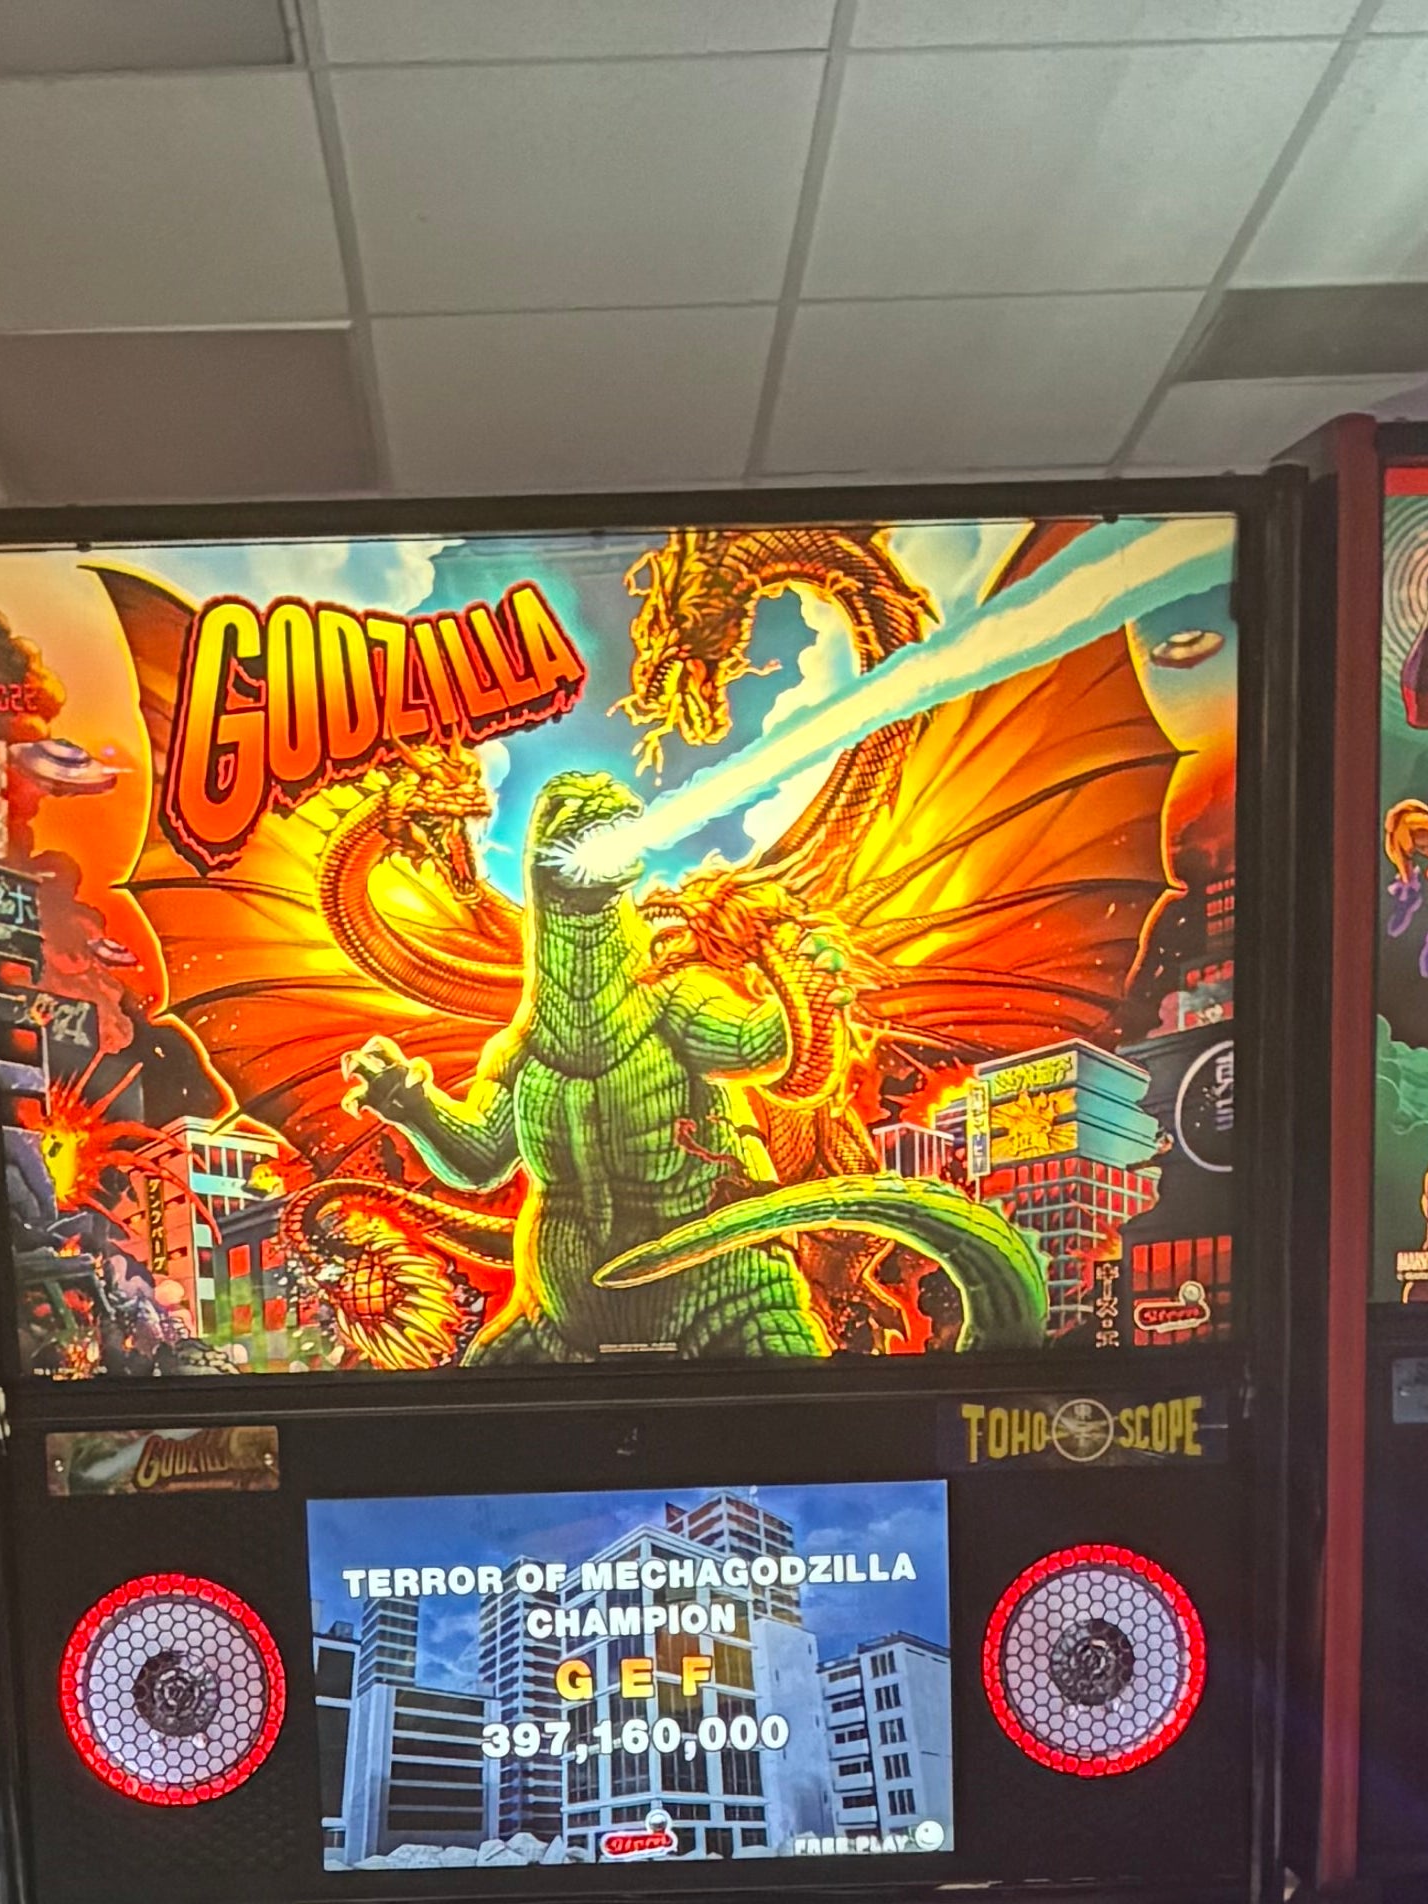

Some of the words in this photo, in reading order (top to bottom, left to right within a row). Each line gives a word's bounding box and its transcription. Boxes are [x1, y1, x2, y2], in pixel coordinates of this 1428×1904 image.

[178, 584, 583, 843] GODZILLA
[962, 1403, 1047, 1463] TOHO
[1119, 1395, 1203, 1456] SCOPE
[343, 1564, 504, 1599] TERROR
[516, 1562, 566, 1594] OF
[581, 1552, 917, 1592] MECHAGODZILLA
[526, 1603, 736, 1639] CHAMPION
[555, 1659, 594, 1701] G
[620, 1657, 655, 1699] E
[681, 1655, 714, 1697] F
[481, 1714, 790, 1763] 397,160,000
[794, 1838, 850, 1856] FREE
[860, 1835, 910, 1854] PLAY
